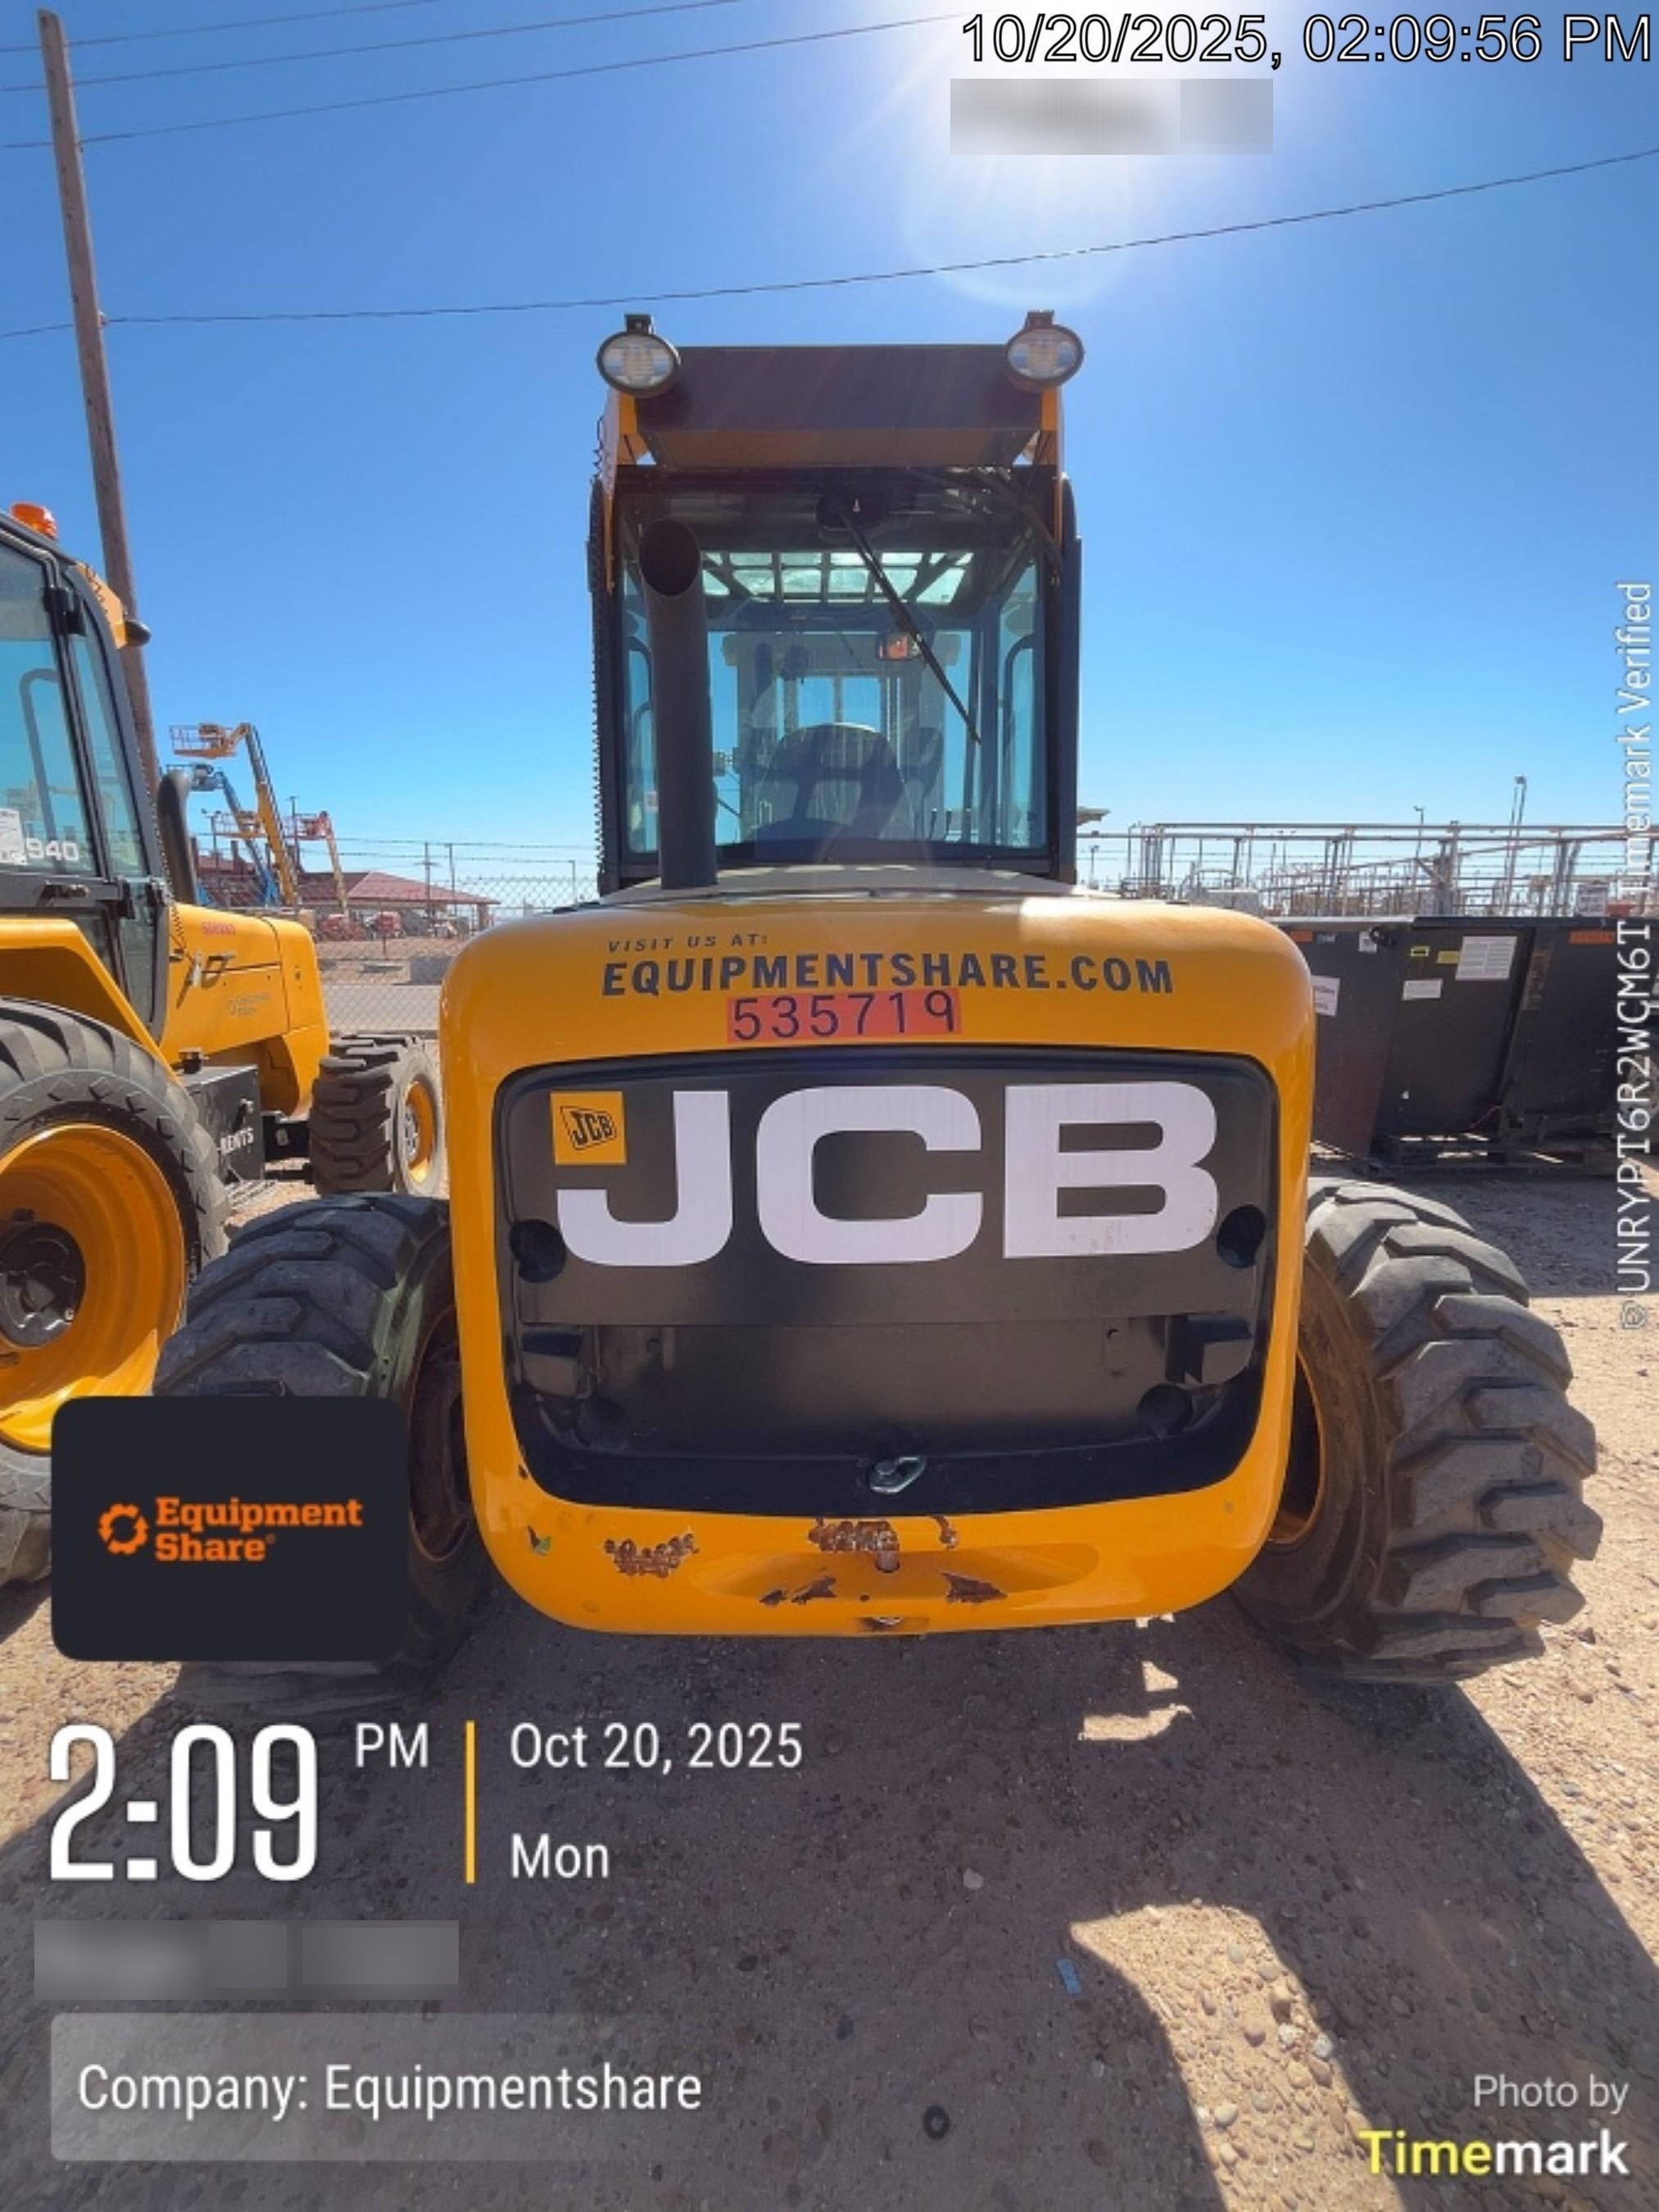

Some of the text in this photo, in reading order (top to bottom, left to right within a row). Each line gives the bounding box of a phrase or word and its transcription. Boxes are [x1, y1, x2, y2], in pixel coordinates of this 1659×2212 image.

[26, 837, 79, 861] 940
[609, 933, 768, 952] VISIT US AT:
[602, 953, 1173, 996] EQUIPMENTSHARE.COM
[733, 990, 955, 1040] 535719
[569, 1110, 613, 1145] JCB
[555, 1081, 1219, 1267] JCB
